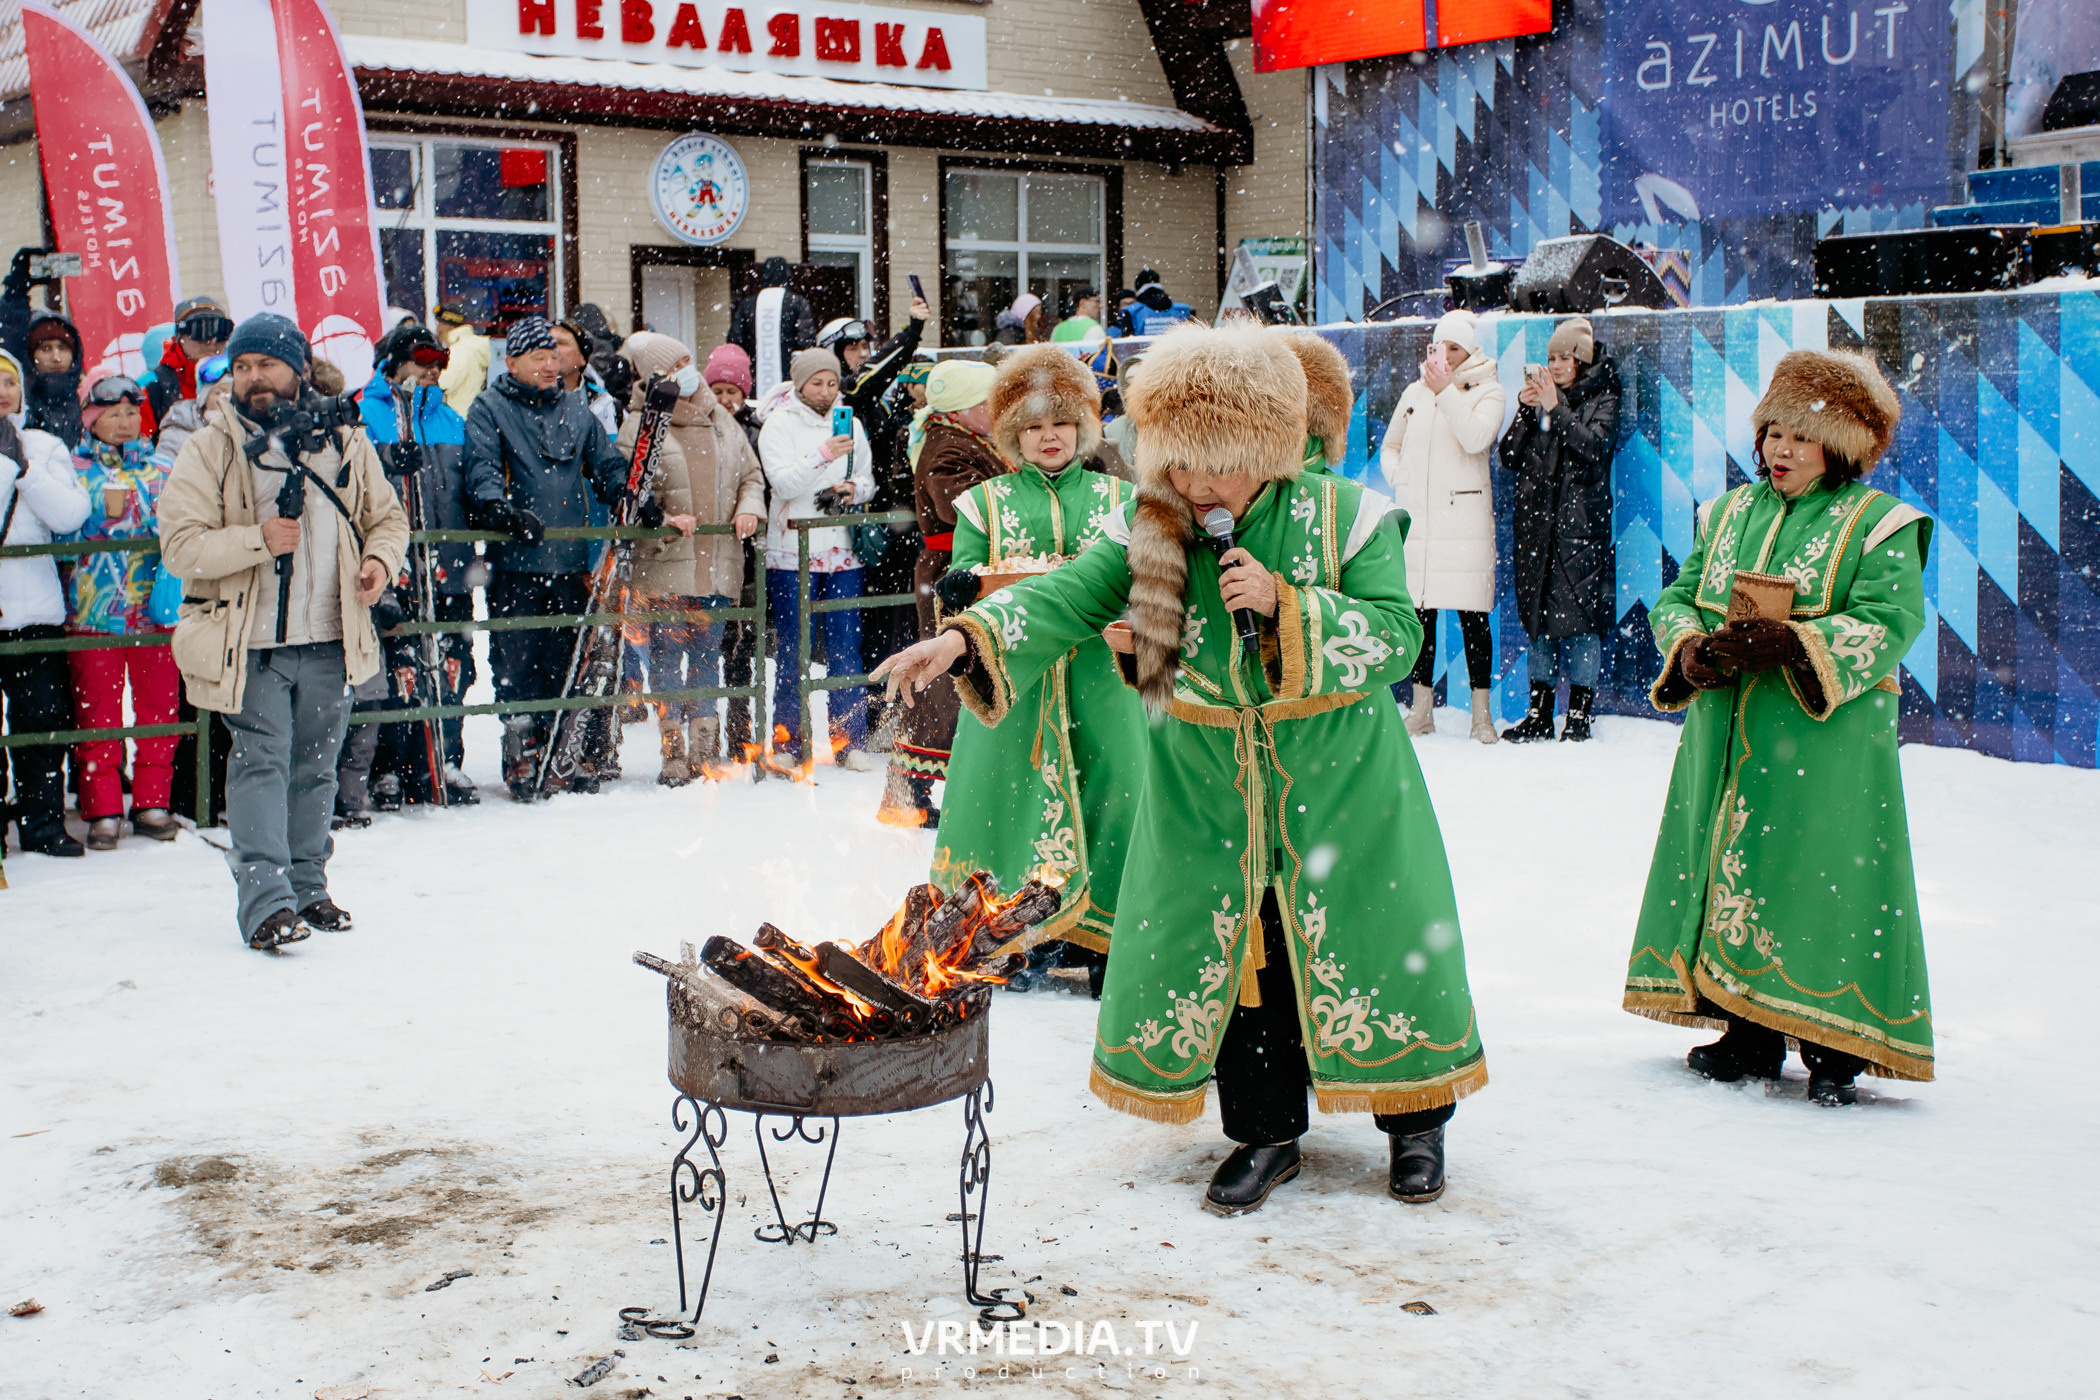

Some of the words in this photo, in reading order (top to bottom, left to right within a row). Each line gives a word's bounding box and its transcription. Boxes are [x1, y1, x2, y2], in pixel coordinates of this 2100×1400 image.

[519, 0, 952, 71] НЕВАЛЯШКА
[1709, 89, 1818, 128] HOTELS
[638, 411, 673, 508] SALOMON
